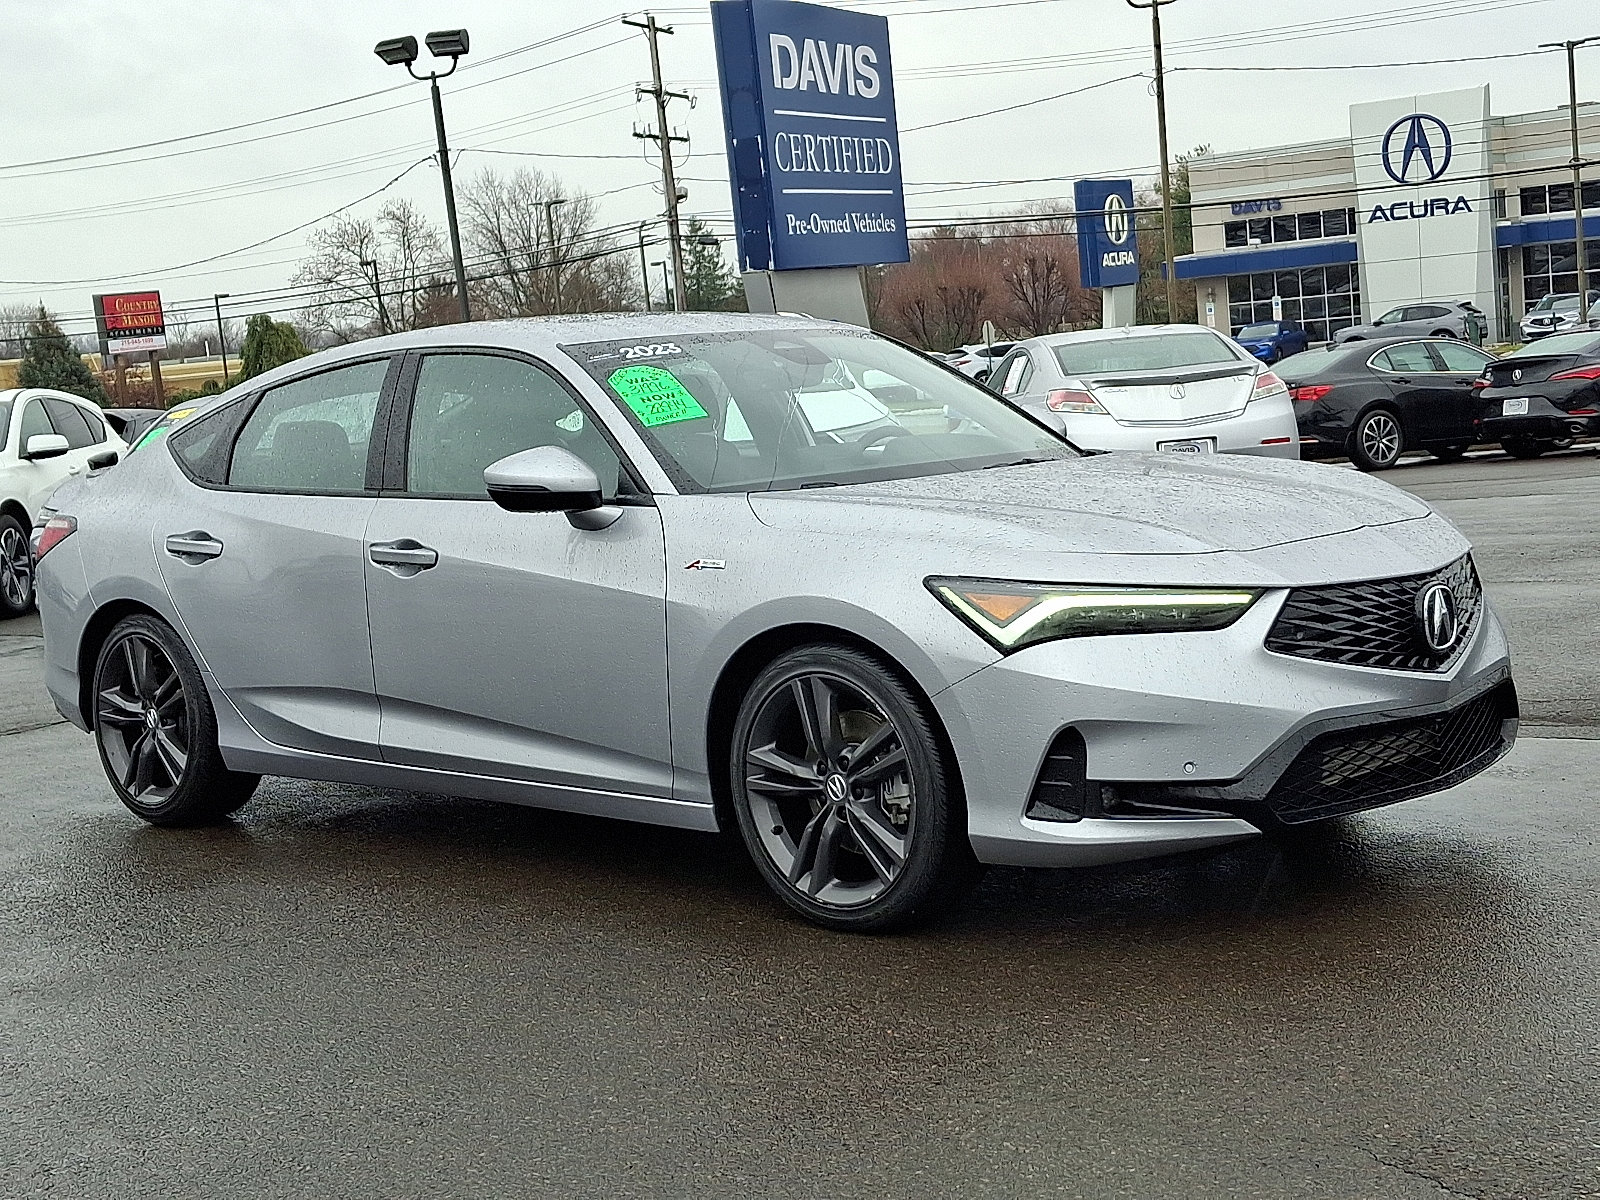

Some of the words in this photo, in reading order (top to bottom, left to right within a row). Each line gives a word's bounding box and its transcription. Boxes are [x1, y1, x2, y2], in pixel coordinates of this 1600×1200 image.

[769, 33, 880, 98] DAVIS
[774, 131, 893, 174] CERTIFIED
[1231, 200, 1281, 215] DAVIS
[1368, 195, 1472, 223] ACURA
[786, 213, 850, 235] Pre-Owned
[851, 213, 895, 232] Vehicles
[1102, 250, 1135, 267] ACURA
[619, 343, 681, 358] 2023
[641, 392, 675, 403] NOW
